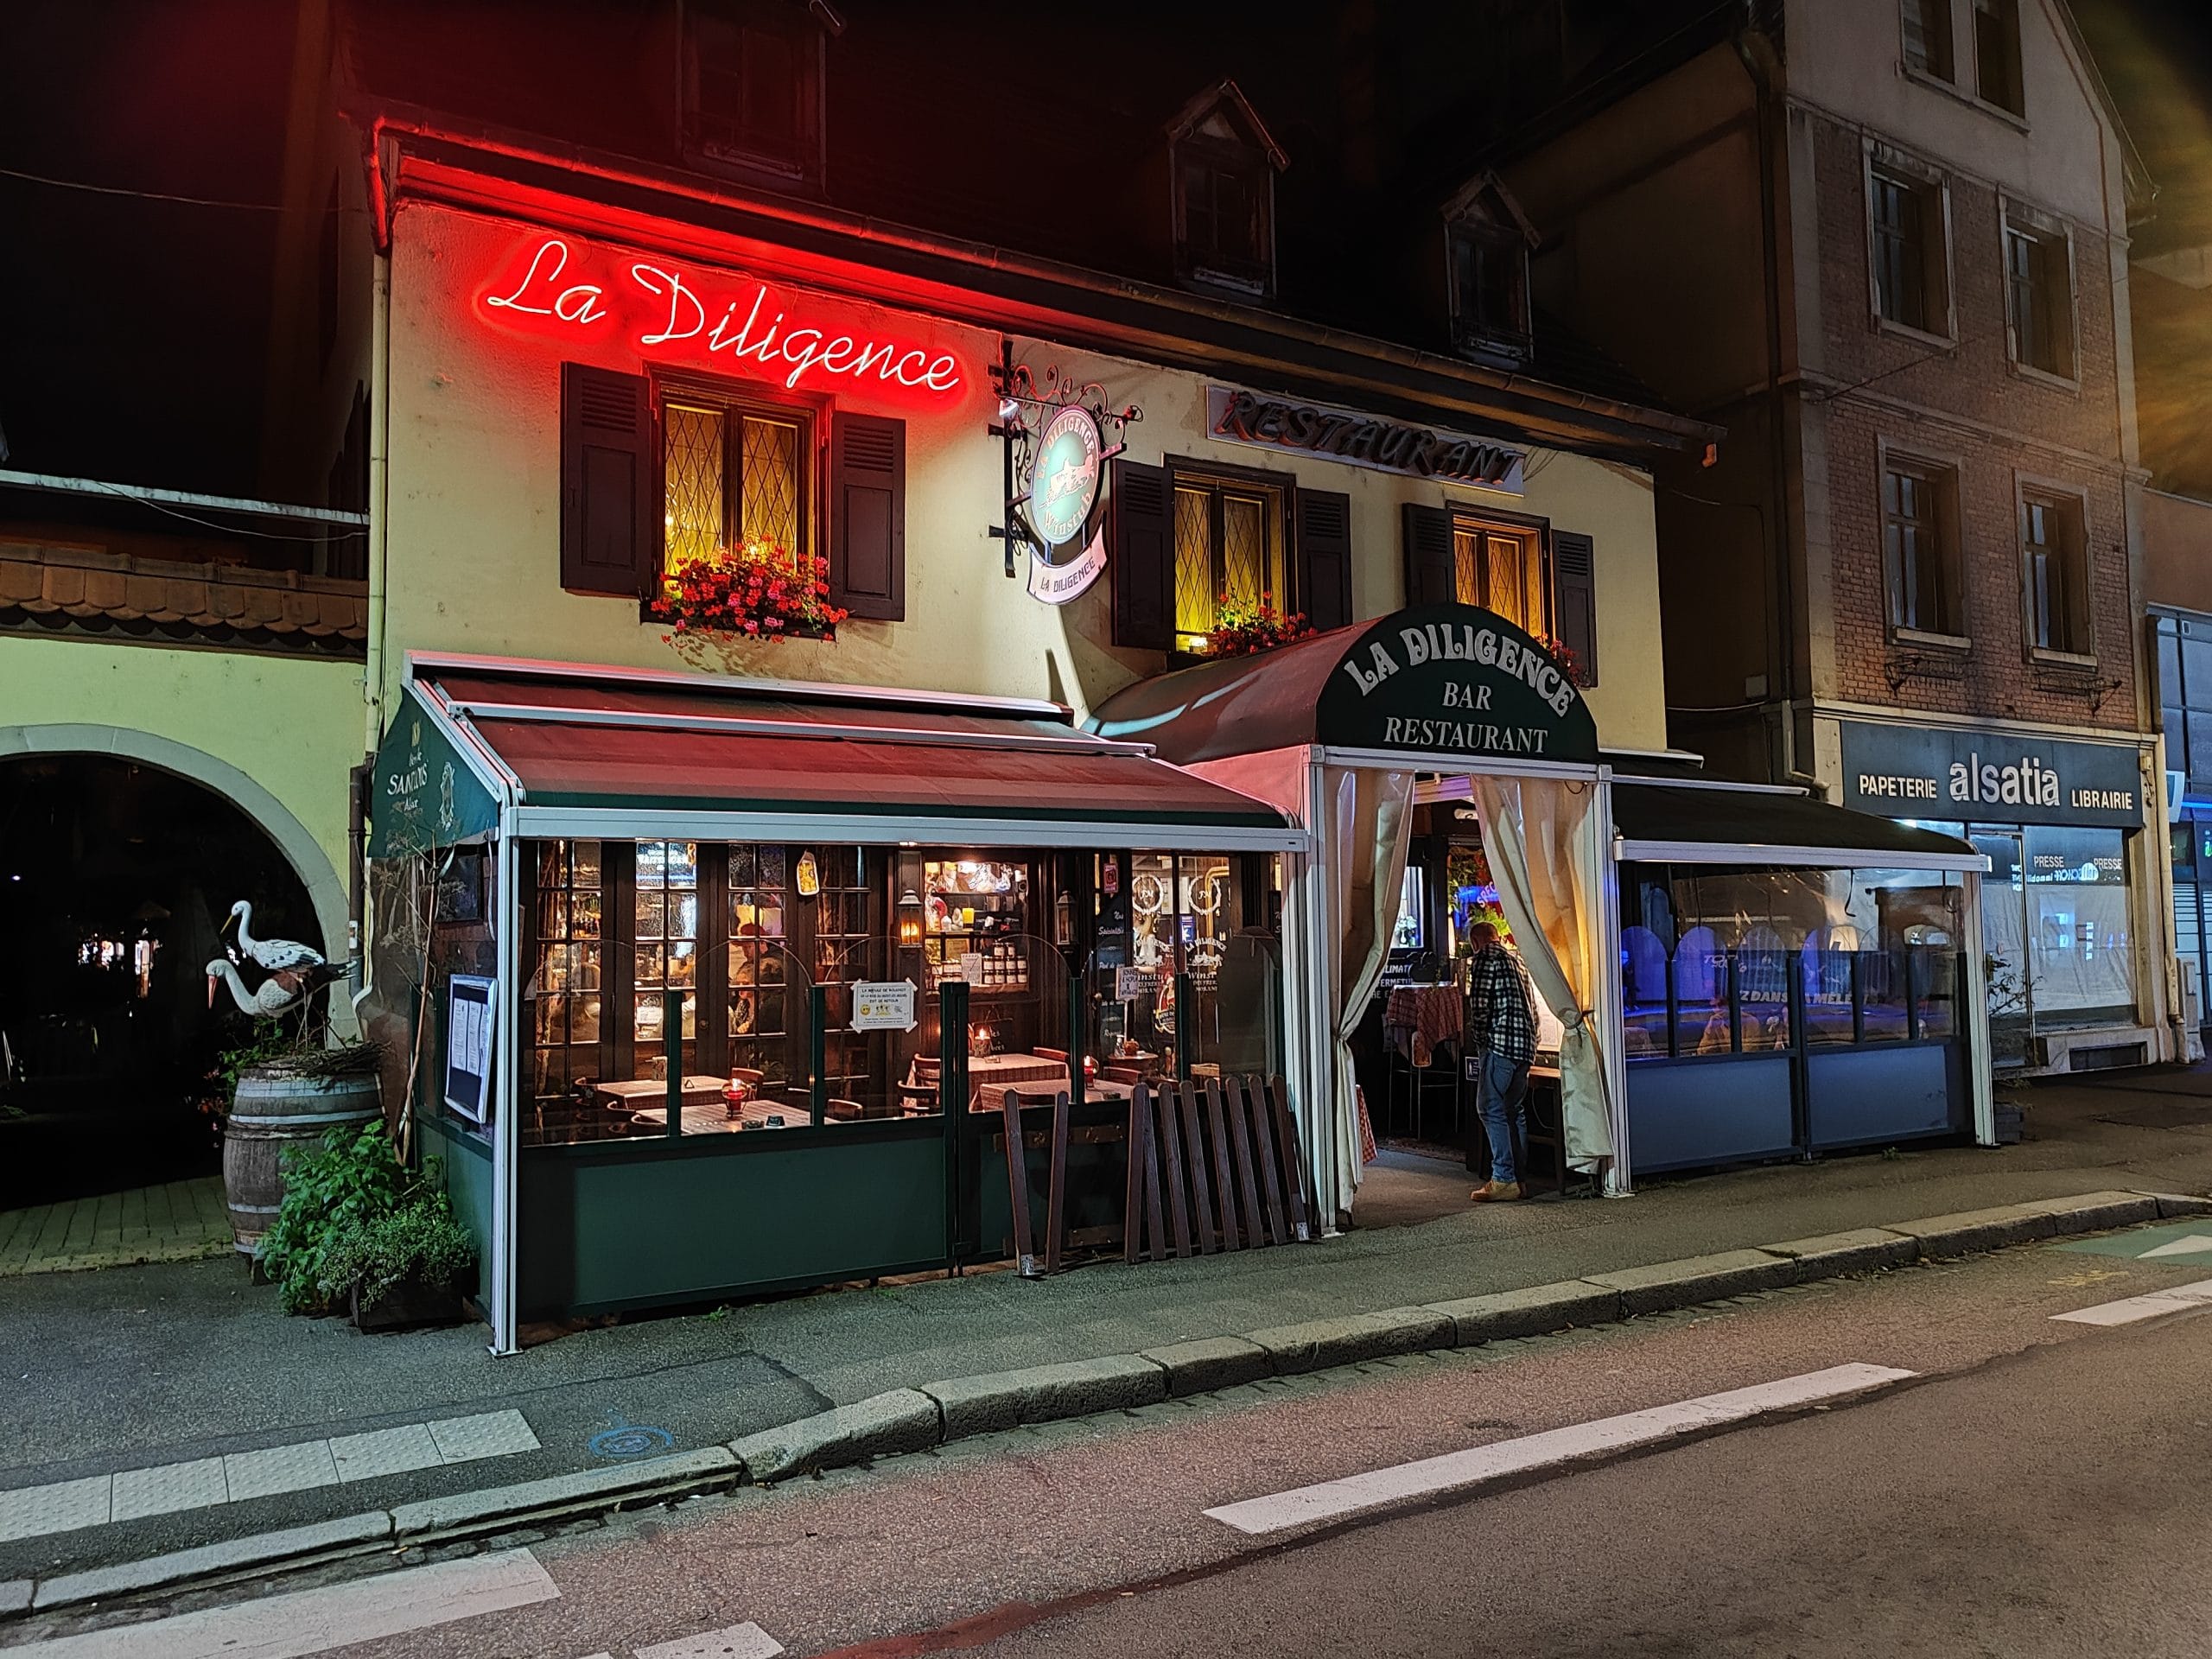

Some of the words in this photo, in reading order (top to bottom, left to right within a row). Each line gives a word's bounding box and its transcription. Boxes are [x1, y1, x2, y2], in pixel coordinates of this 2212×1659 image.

[486, 239, 607, 324] La
[631, 263, 961, 391] Diligence
[1038, 455, 1049, 480] LA
[1046, 416, 1095, 455] DILIGENCE
[1214, 391, 1527, 486] RESTAURANT
[1043, 492, 1093, 537] Winstub
[1040, 576, 1050, 592] LA
[1052, 556, 1096, 593] DILIGENCE
[1344, 642, 1400, 696] LA
[1400, 623, 1575, 717] DILIGENCE
[1441, 681, 1492, 711] BAR
[1382, 716, 1548, 753] RESTAURANT
[1859, 773, 1938, 800] PAPETERIE
[1948, 751, 2061, 807] alsatia
[2071, 789, 2134, 810] LIBRAIRIE
[2033, 855, 2065, 868] PRESSE
[2093, 857, 2123, 871] PRESSE
